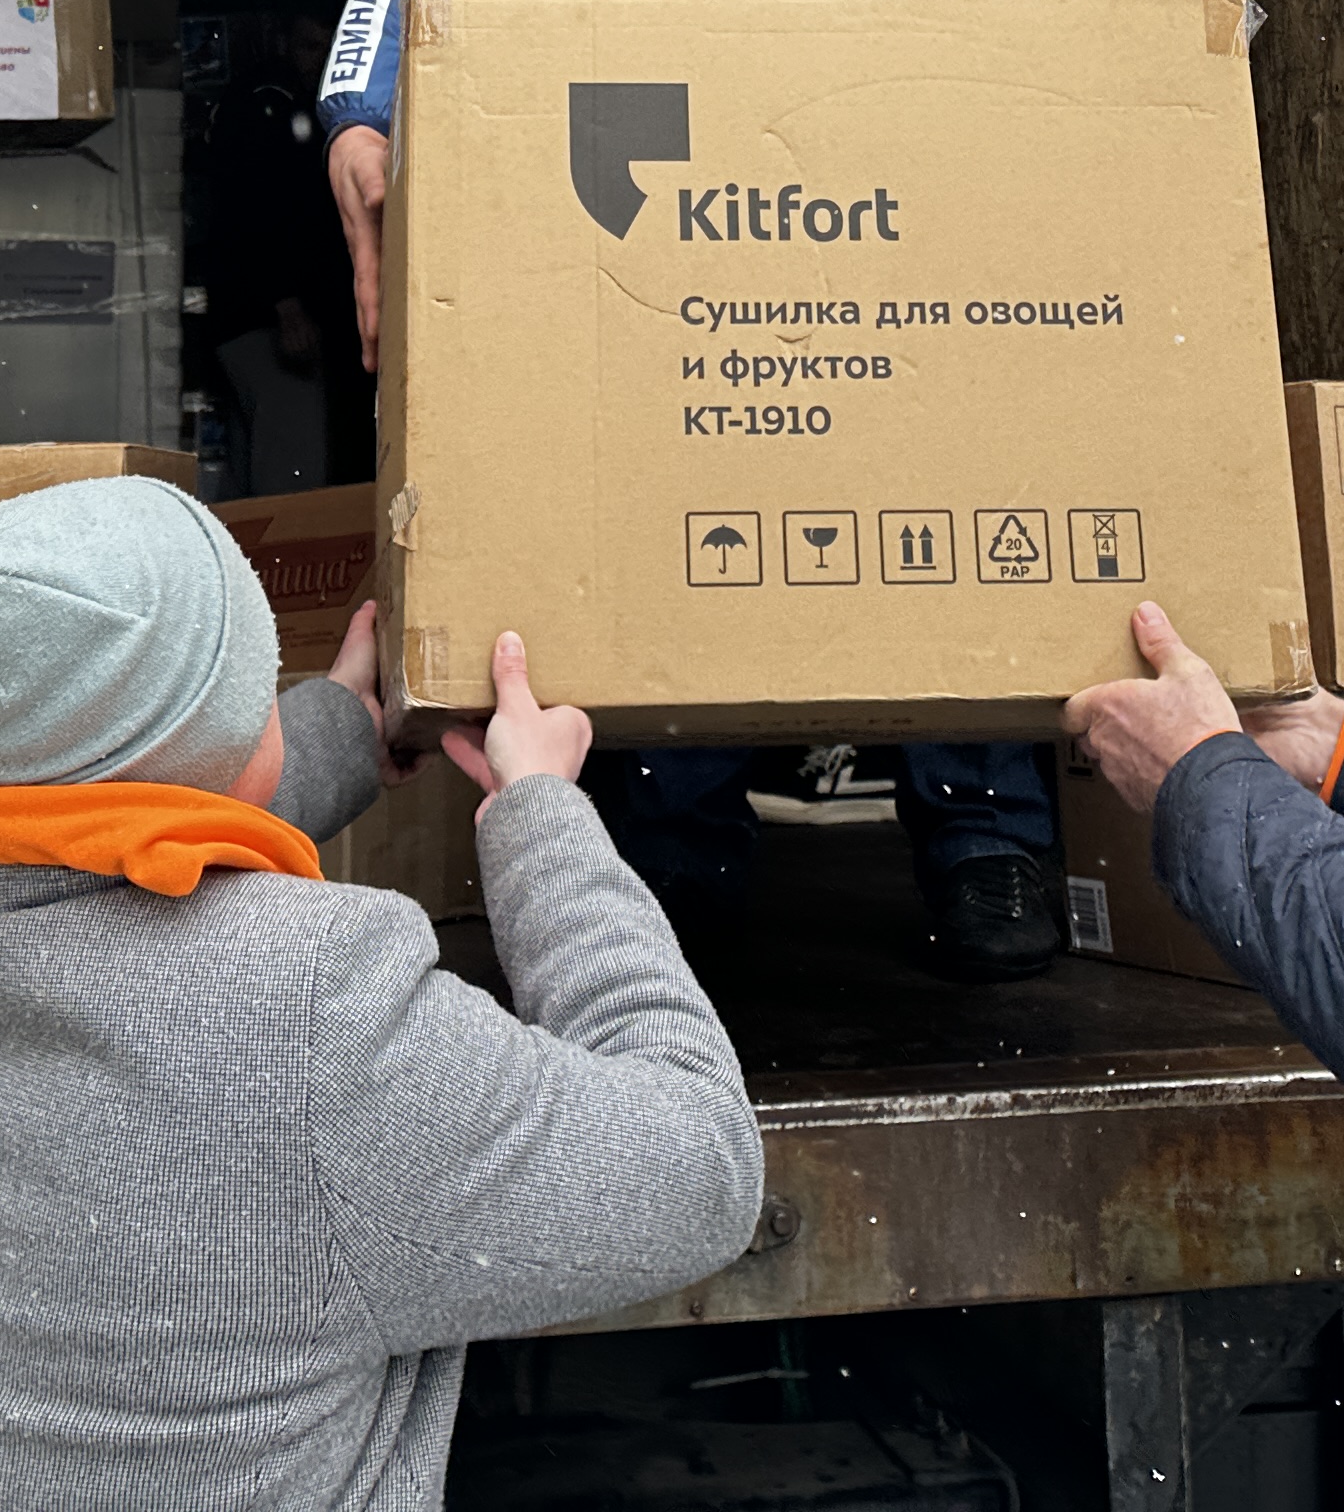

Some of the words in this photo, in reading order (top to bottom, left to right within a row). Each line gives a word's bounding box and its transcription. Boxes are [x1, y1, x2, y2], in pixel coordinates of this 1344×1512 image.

[678, 183, 900, 242] Kitfort
[680, 296, 860, 332] Сушилка
[875, 301, 951, 330] для
[964, 295, 1124, 330] овощей
[682, 356, 705, 379] и
[719, 349, 893, 388] фруктов
[1005, 538, 1022, 551] 20
[1000, 565, 1030, 579] PAP
